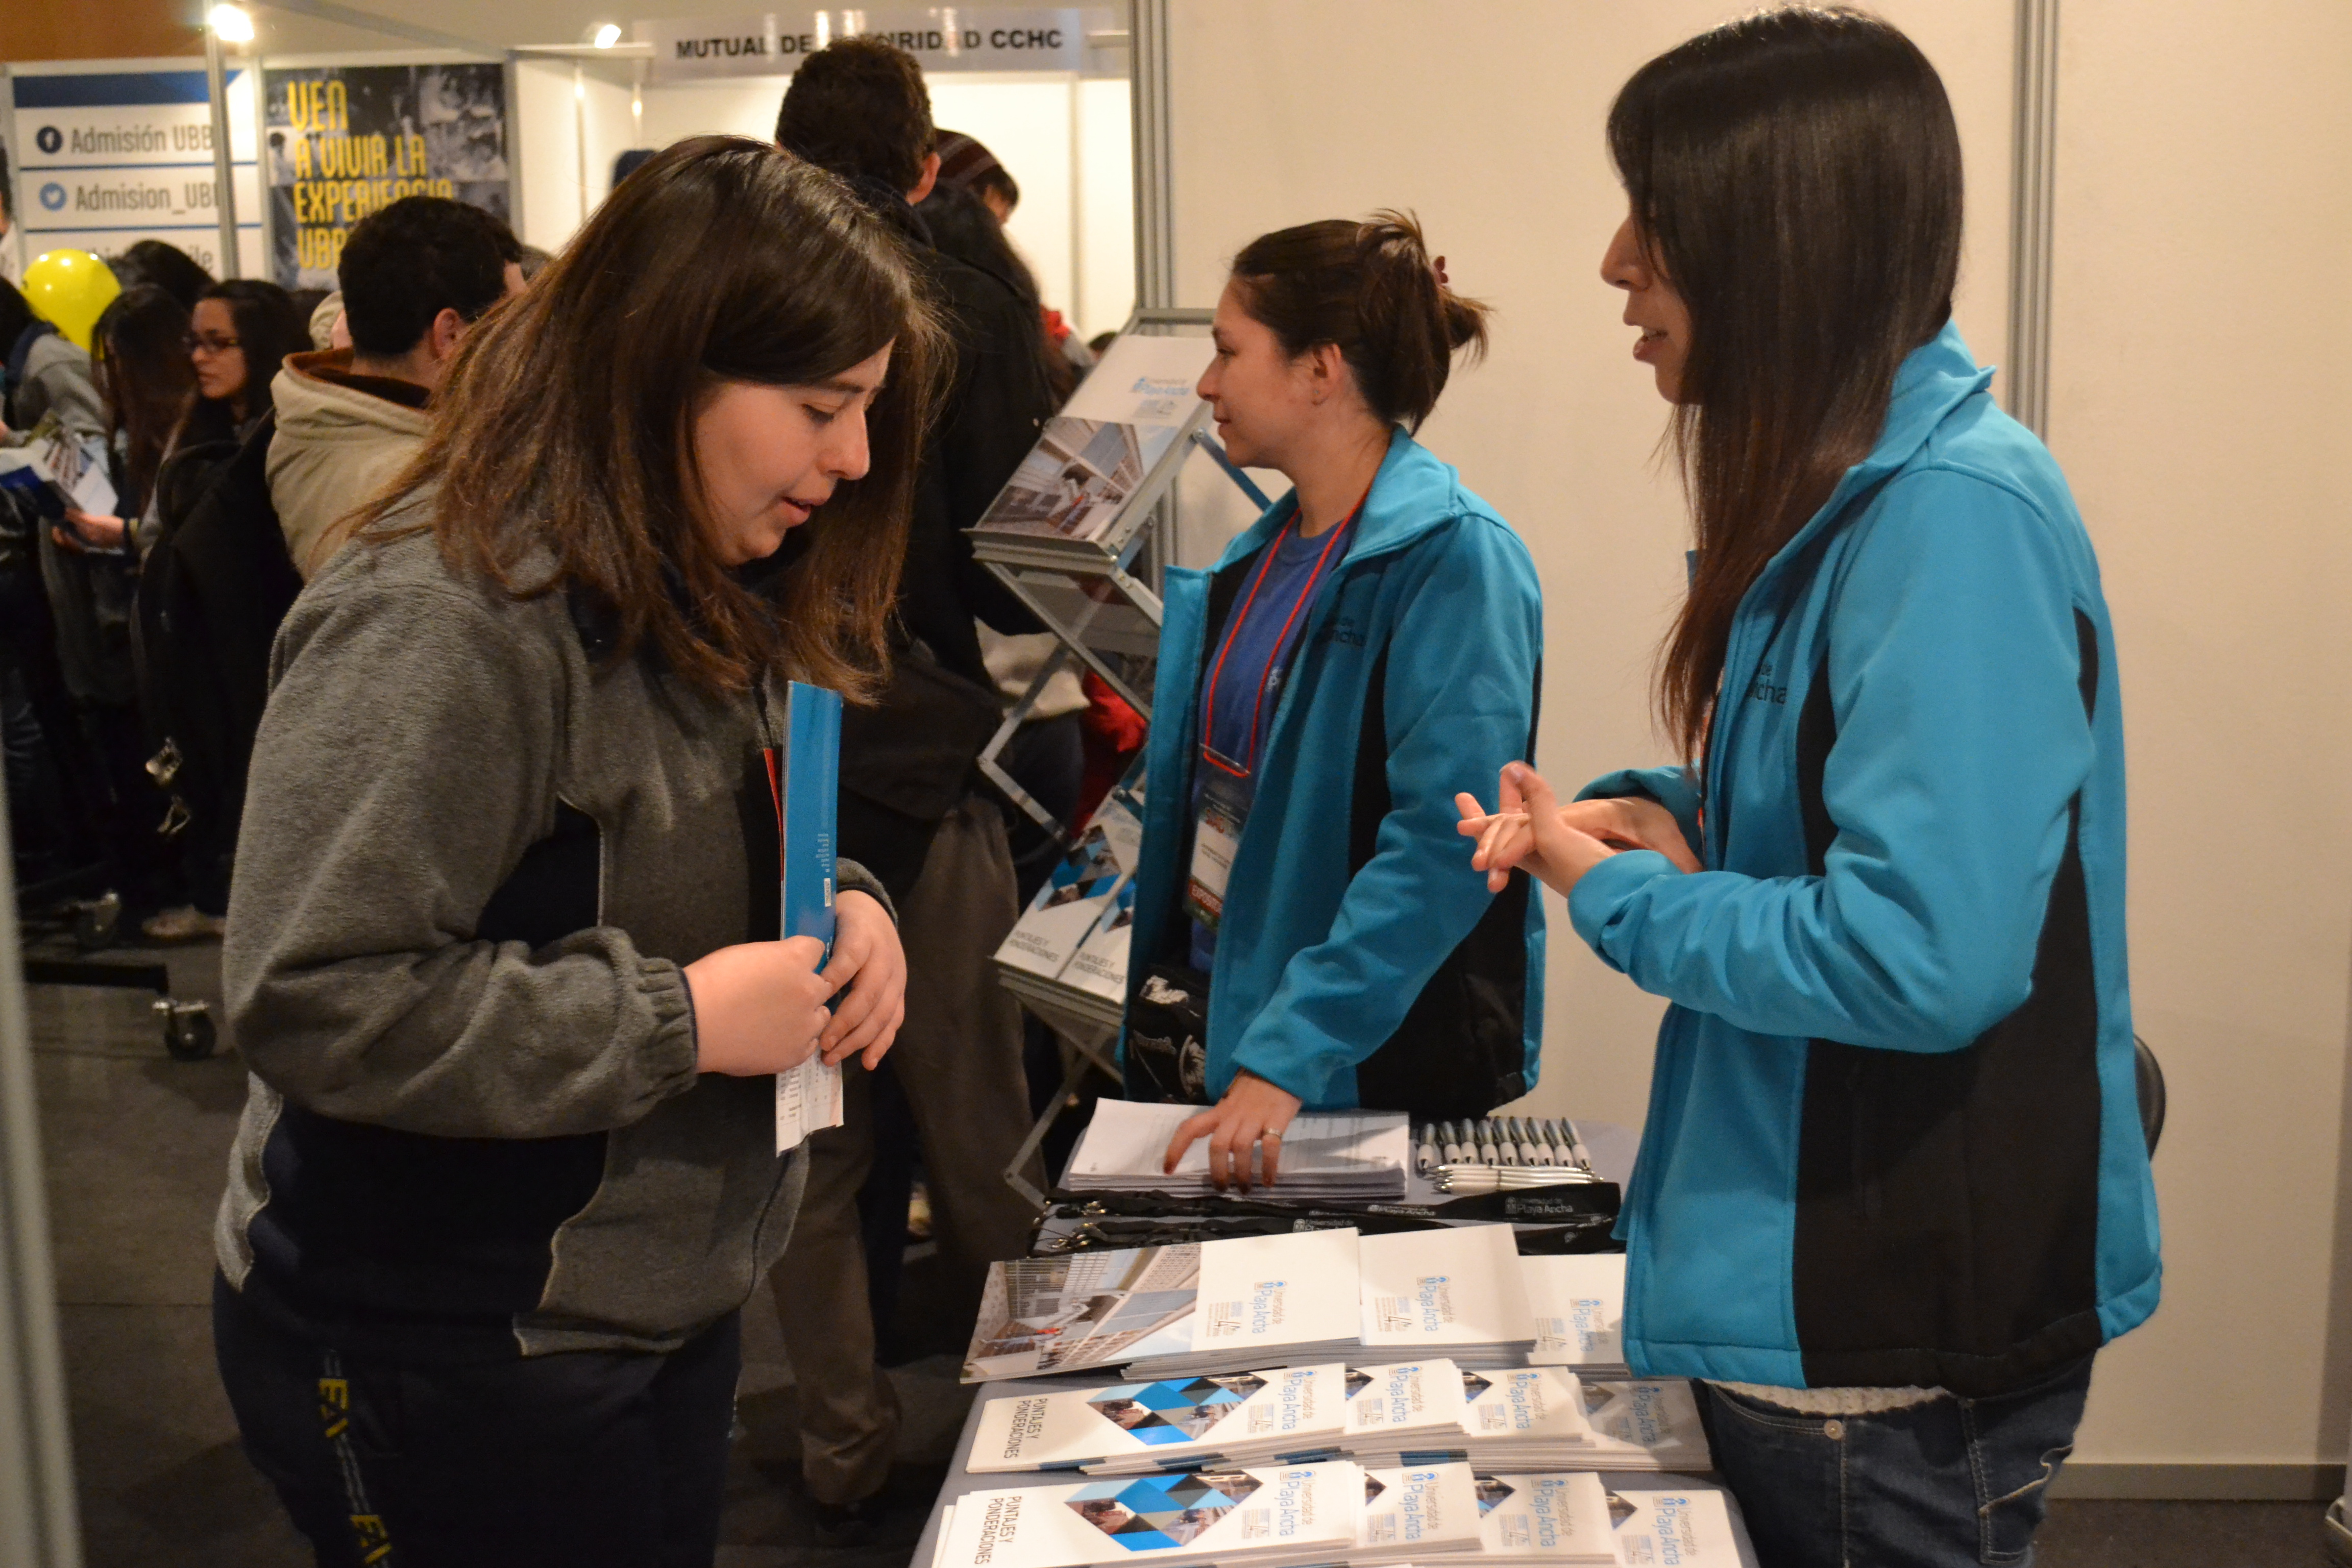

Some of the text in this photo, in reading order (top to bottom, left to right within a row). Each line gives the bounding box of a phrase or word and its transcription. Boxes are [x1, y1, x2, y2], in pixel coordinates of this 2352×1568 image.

[781, 34, 814, 54] DE
[990, 30, 1062, 50] CCHC
[288, 80, 349, 132] VEN
[70, 124, 167, 154] Admisión
[295, 138, 312, 178] A
[395, 133, 427, 177] LA
[76, 182, 219, 215] Admision_UB
[1545, 1204, 1574, 1213] Ancha
[1248, 1290, 1272, 1333] Playa Ancha
[1415, 1286, 1442, 1331] Playa Ancha
[1026, 1398, 1048, 1433] PUNTAJES
[1278, 1379, 1302, 1429] Playa Ancha
[1385, 1375, 1411, 1422] Playa Ancha
[1505, 1382, 1534, 1429] Playa Ancha
[1003, 1400, 1031, 1458] PONDERACIONES
[974, 1498, 1004, 1564] PONDERACIONES
[999, 1496, 1022, 1537] PUNTAJES
[1274, 1481, 1300, 1536] Playa Ancha
[1398, 1484, 1426, 1539] Playa Ancha
[1529, 1489, 1560, 1547] Playa Ancha
[1651, 1508, 1684, 1565] Playa Ancha
